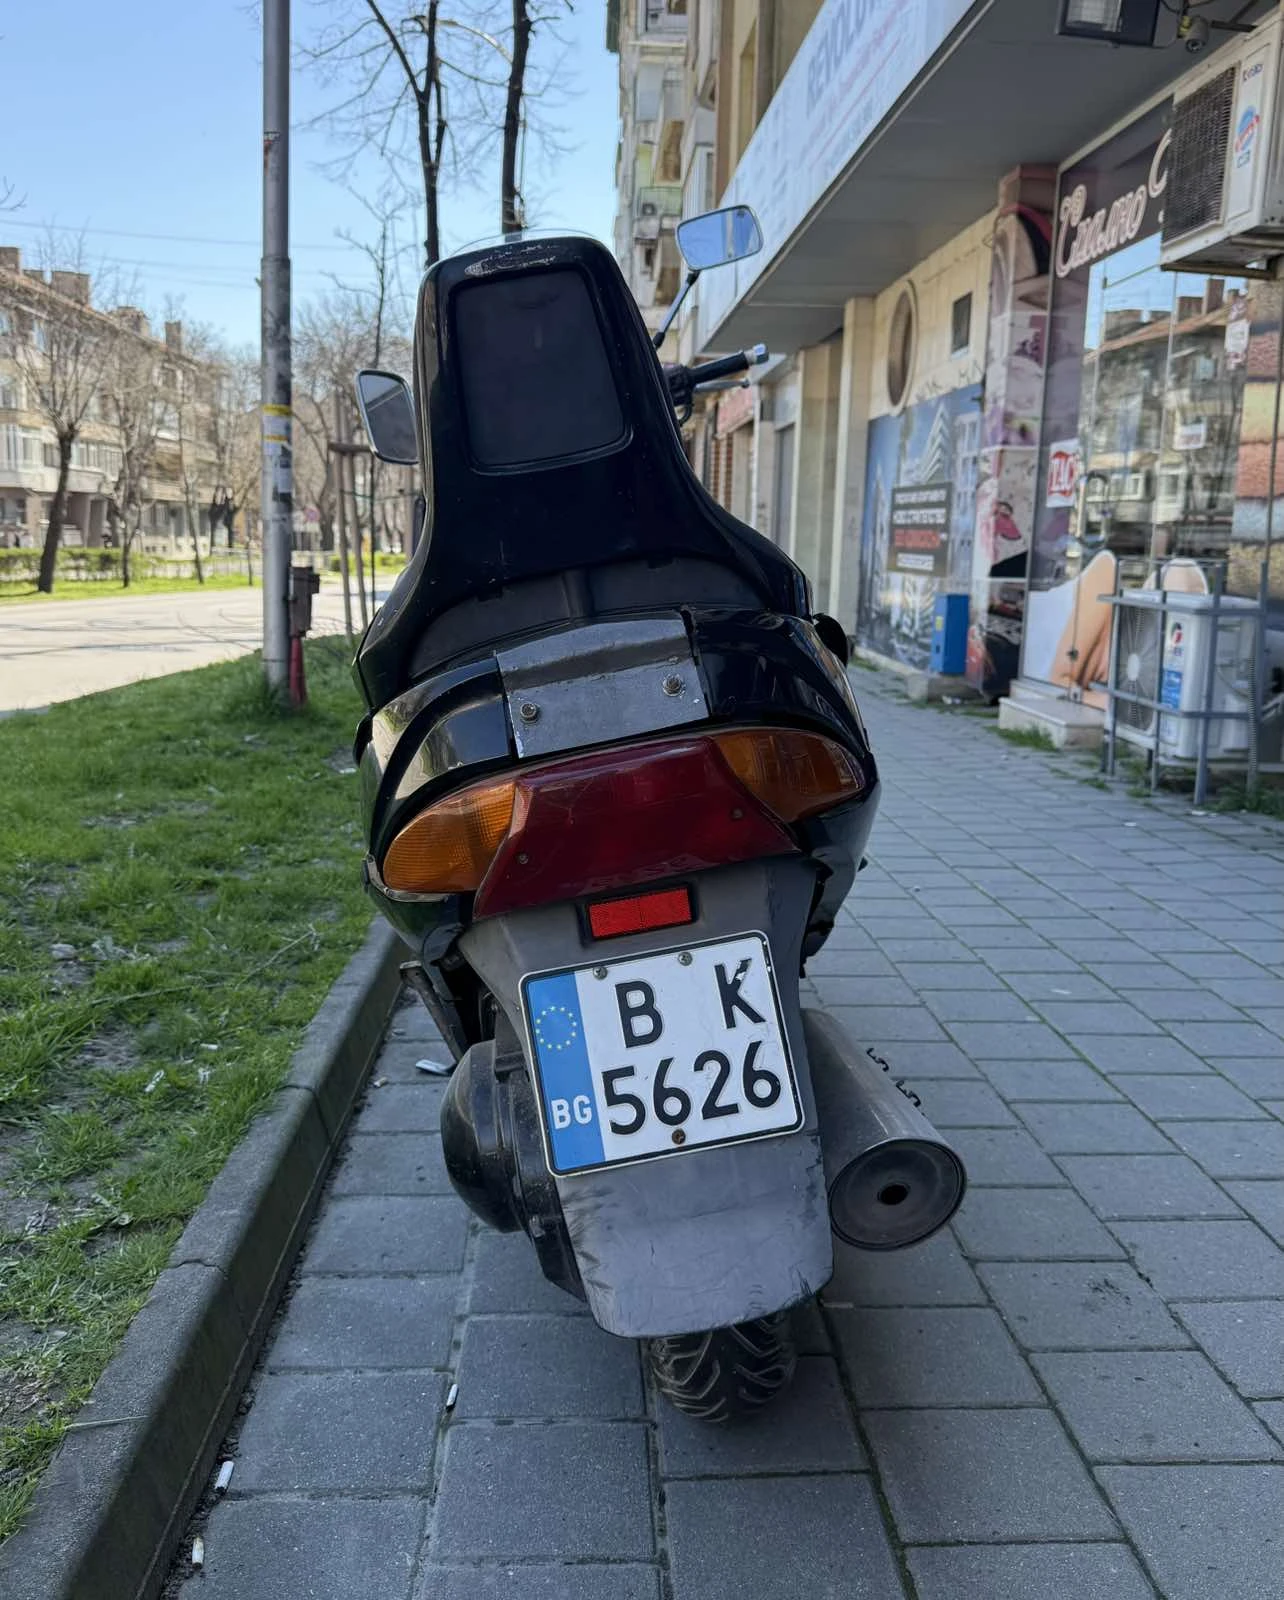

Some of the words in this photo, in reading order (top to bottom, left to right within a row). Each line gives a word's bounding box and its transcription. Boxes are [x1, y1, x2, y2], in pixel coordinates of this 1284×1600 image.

[614, 980, 664, 1049] B
[714, 957, 767, 1030] K
[550, 1095, 594, 1130] BG
[601, 1040, 782, 1136] 5626
